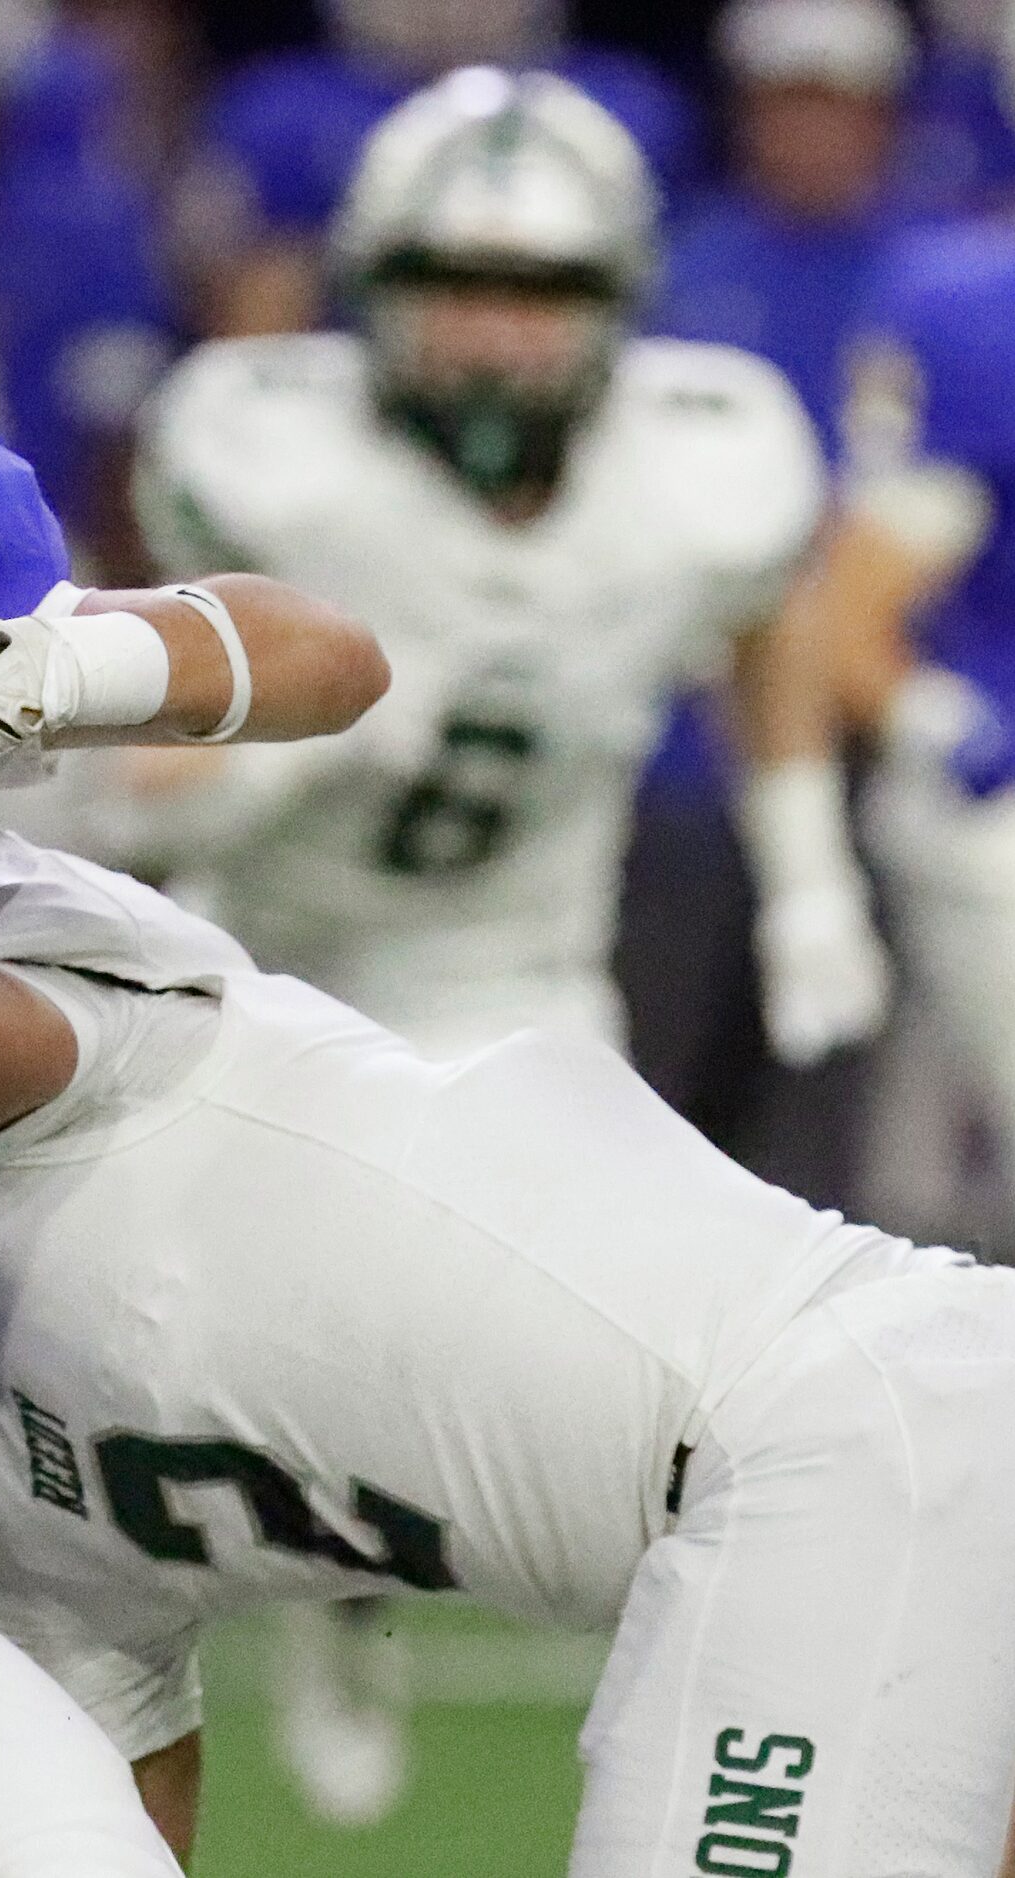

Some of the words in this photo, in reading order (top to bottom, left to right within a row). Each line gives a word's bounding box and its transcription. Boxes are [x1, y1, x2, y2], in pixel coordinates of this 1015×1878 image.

[11, 1386, 89, 1520] REEDY
[91, 1429, 461, 1591] 2
[690, 1727, 816, 1878] ONS
